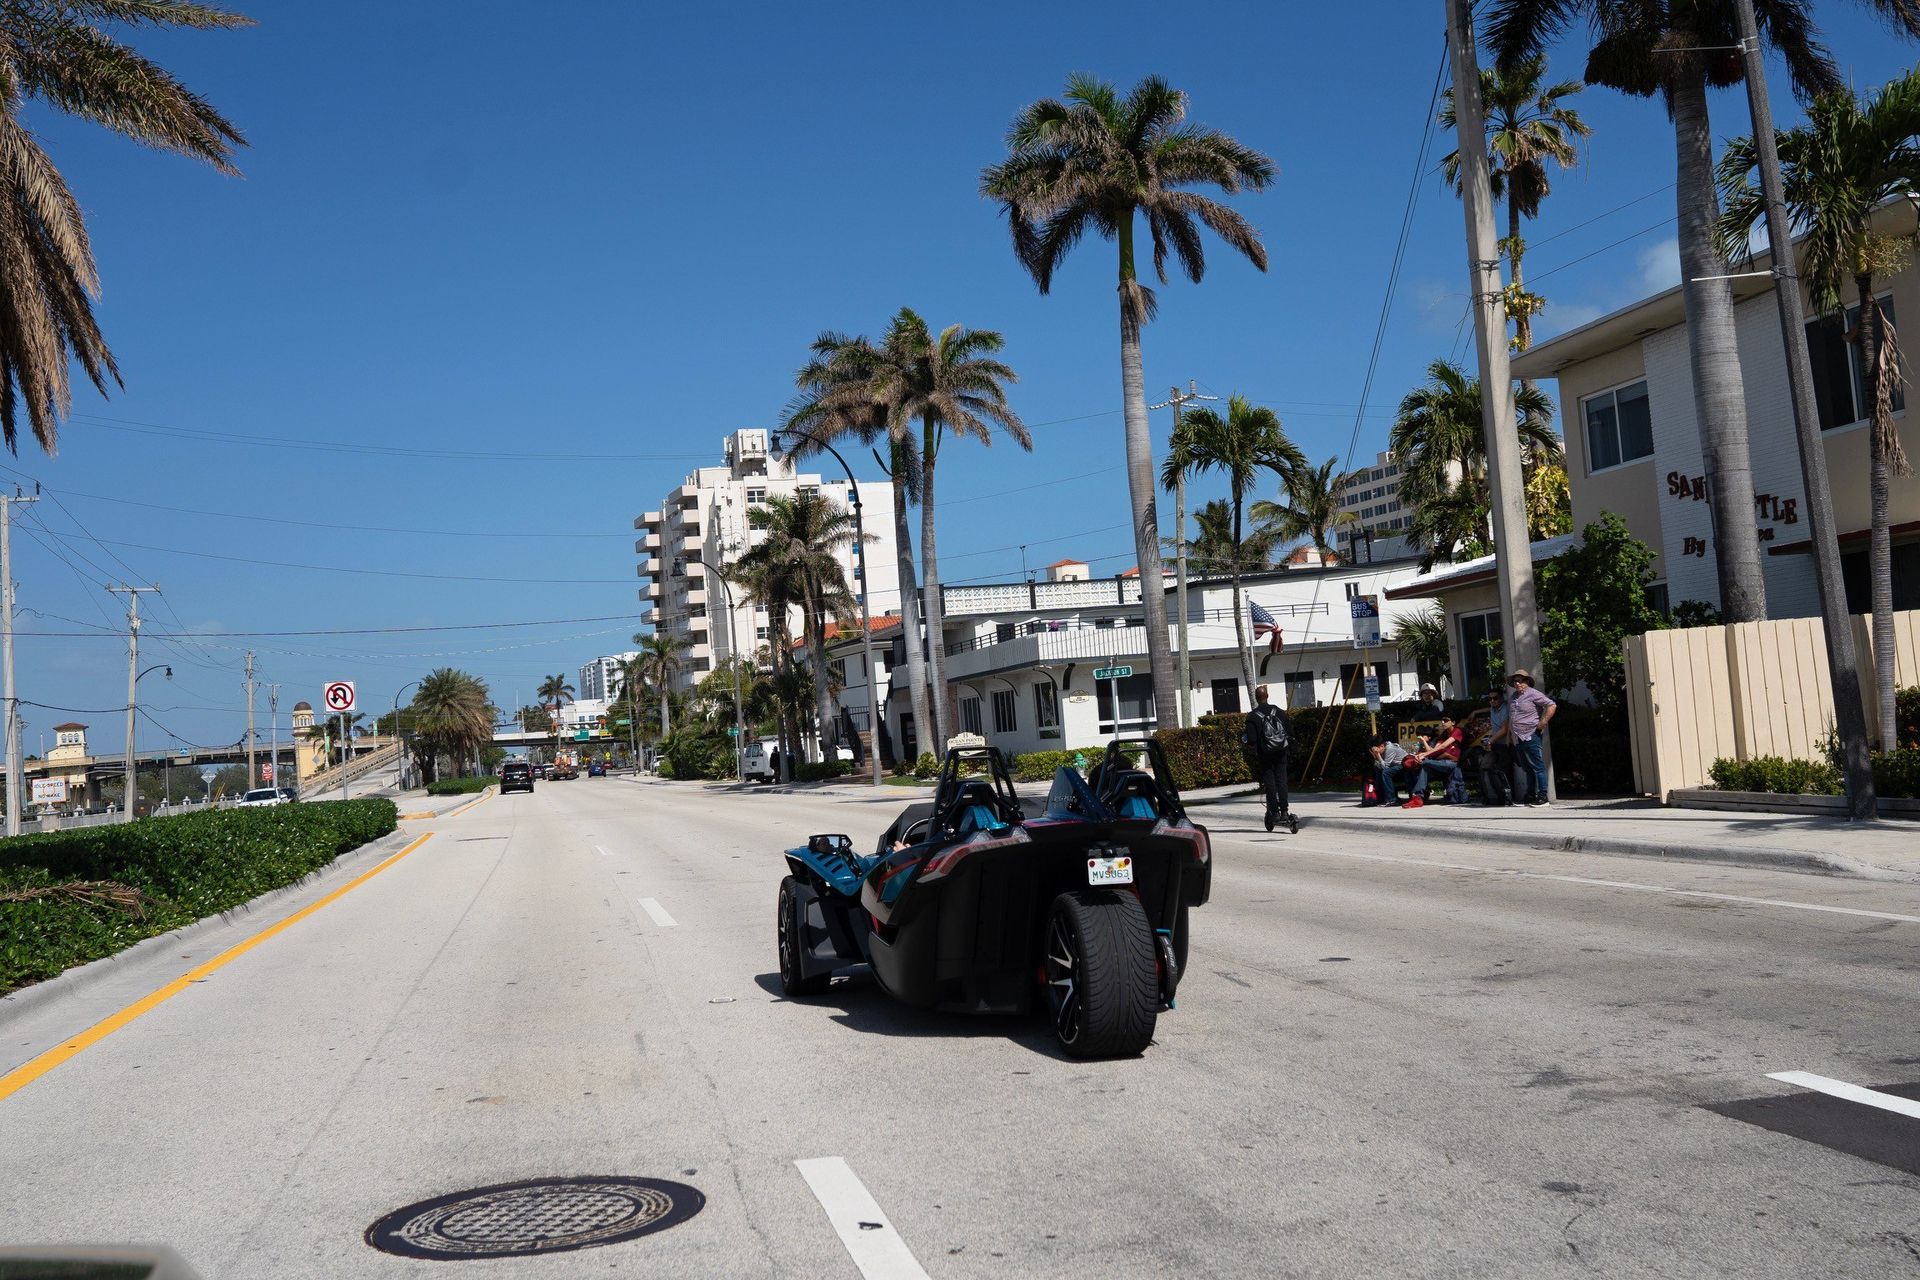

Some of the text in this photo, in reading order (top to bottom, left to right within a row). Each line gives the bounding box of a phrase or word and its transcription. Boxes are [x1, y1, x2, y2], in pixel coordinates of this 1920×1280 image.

[1682, 536, 1706, 557] By
[1351, 602, 1368, 611] BUS
[1352, 609, 1372, 618] STOP
